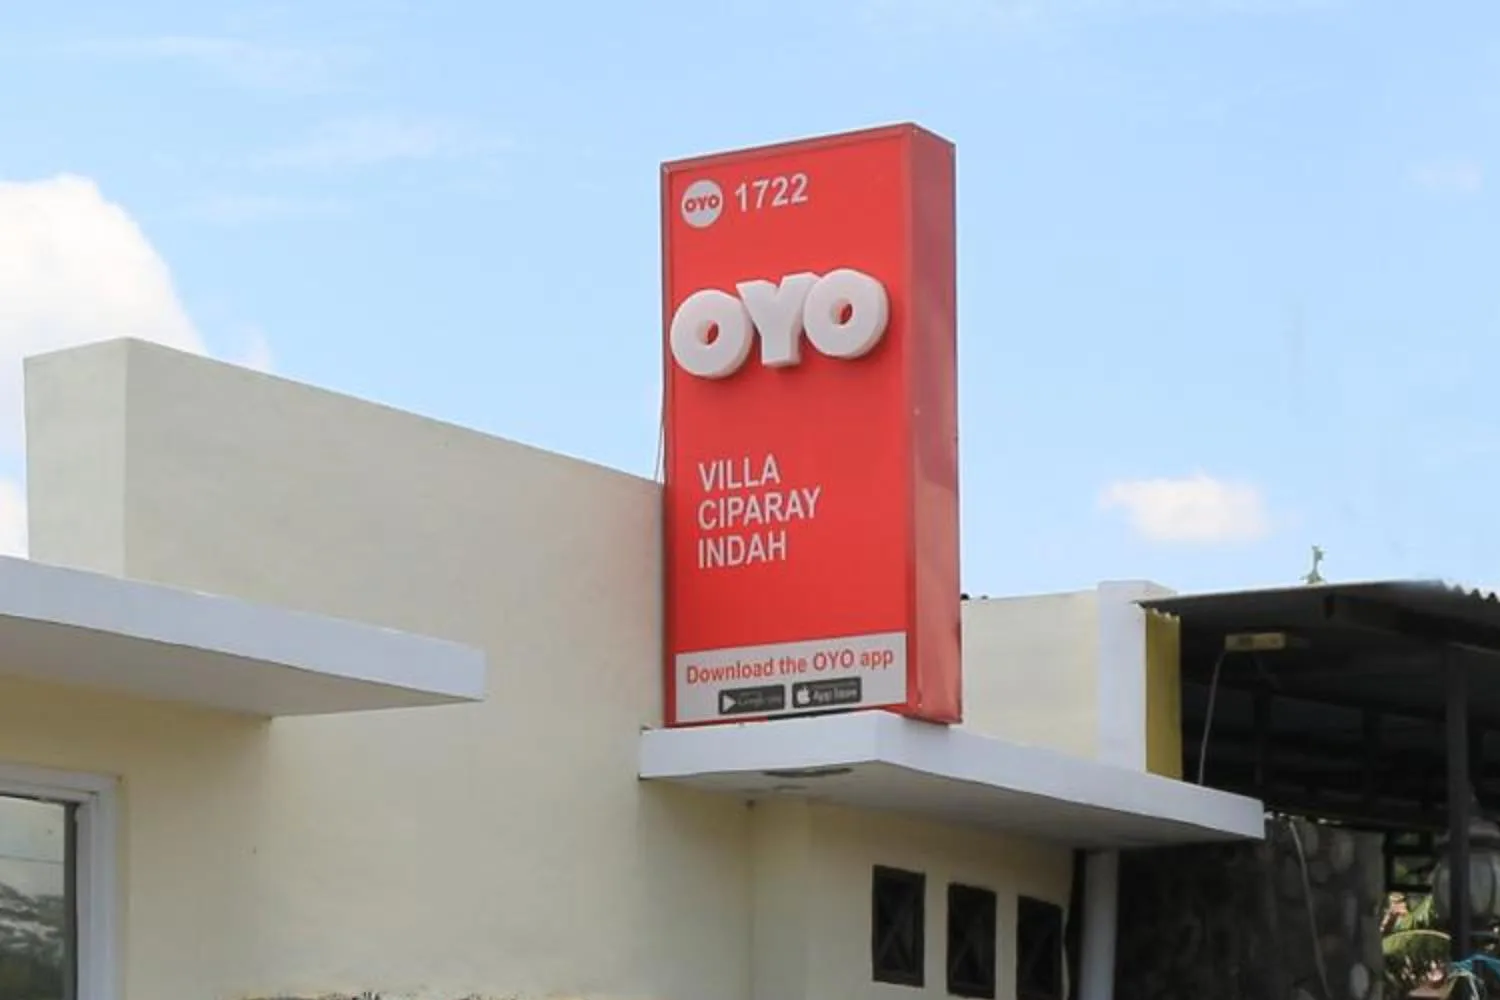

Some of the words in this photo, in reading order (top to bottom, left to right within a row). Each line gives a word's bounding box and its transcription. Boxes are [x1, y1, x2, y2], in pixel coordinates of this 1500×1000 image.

[684, 193, 720, 213] OYO
[735, 173, 808, 212] 1722
[670, 268, 889, 379] OYO
[698, 454, 780, 492] VILLA
[698, 487, 821, 531] CIPARAY
[698, 530, 786, 569] INDAH
[687, 659, 773, 684] Download
[779, 656, 807, 675] the
[813, 649, 854, 672] OYO
[860, 649, 893, 671] app
